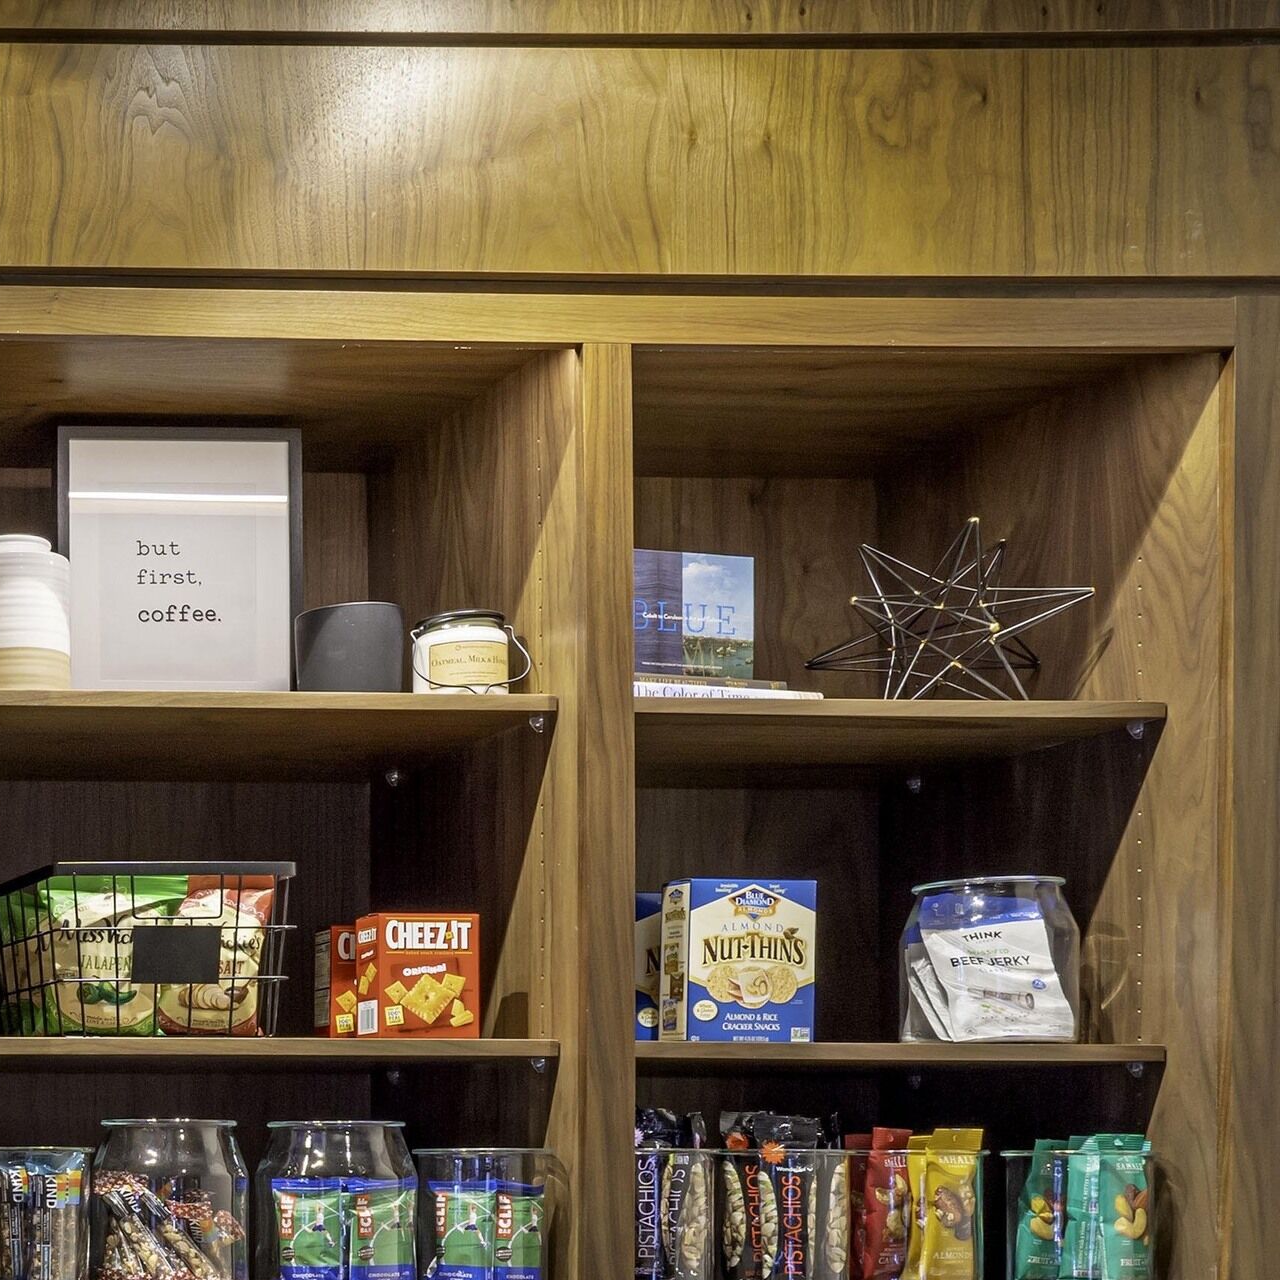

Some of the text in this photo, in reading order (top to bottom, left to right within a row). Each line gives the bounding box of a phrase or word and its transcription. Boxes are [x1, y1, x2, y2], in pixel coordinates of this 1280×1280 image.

[136, 539, 181, 556] but
[137, 568, 202, 587] first,
[138, 604, 222, 622] coffee.
[633, 598, 737, 636] BLUE
[662, 686, 697, 698] Color
[735, 897, 775, 906] DIAMOND
[745, 891, 765, 899] BLUE
[720, 921, 785, 933] ALMOND
[962, 931, 1003, 943] THINK
[950, 955, 1031, 968] BEEF JERKY
[724, 1012, 755, 1021] ALMOND
[762, 1012, 778, 1021] RICE
[722, 1022, 781, 1031] CRACKER SNACKS
[9, 1170, 24, 1203] KIND
[45, 1174, 58, 1209] KIND
[638, 1158, 656, 1259] PISTACHIOS
[782, 1174, 804, 1275] PISTACHIOS
